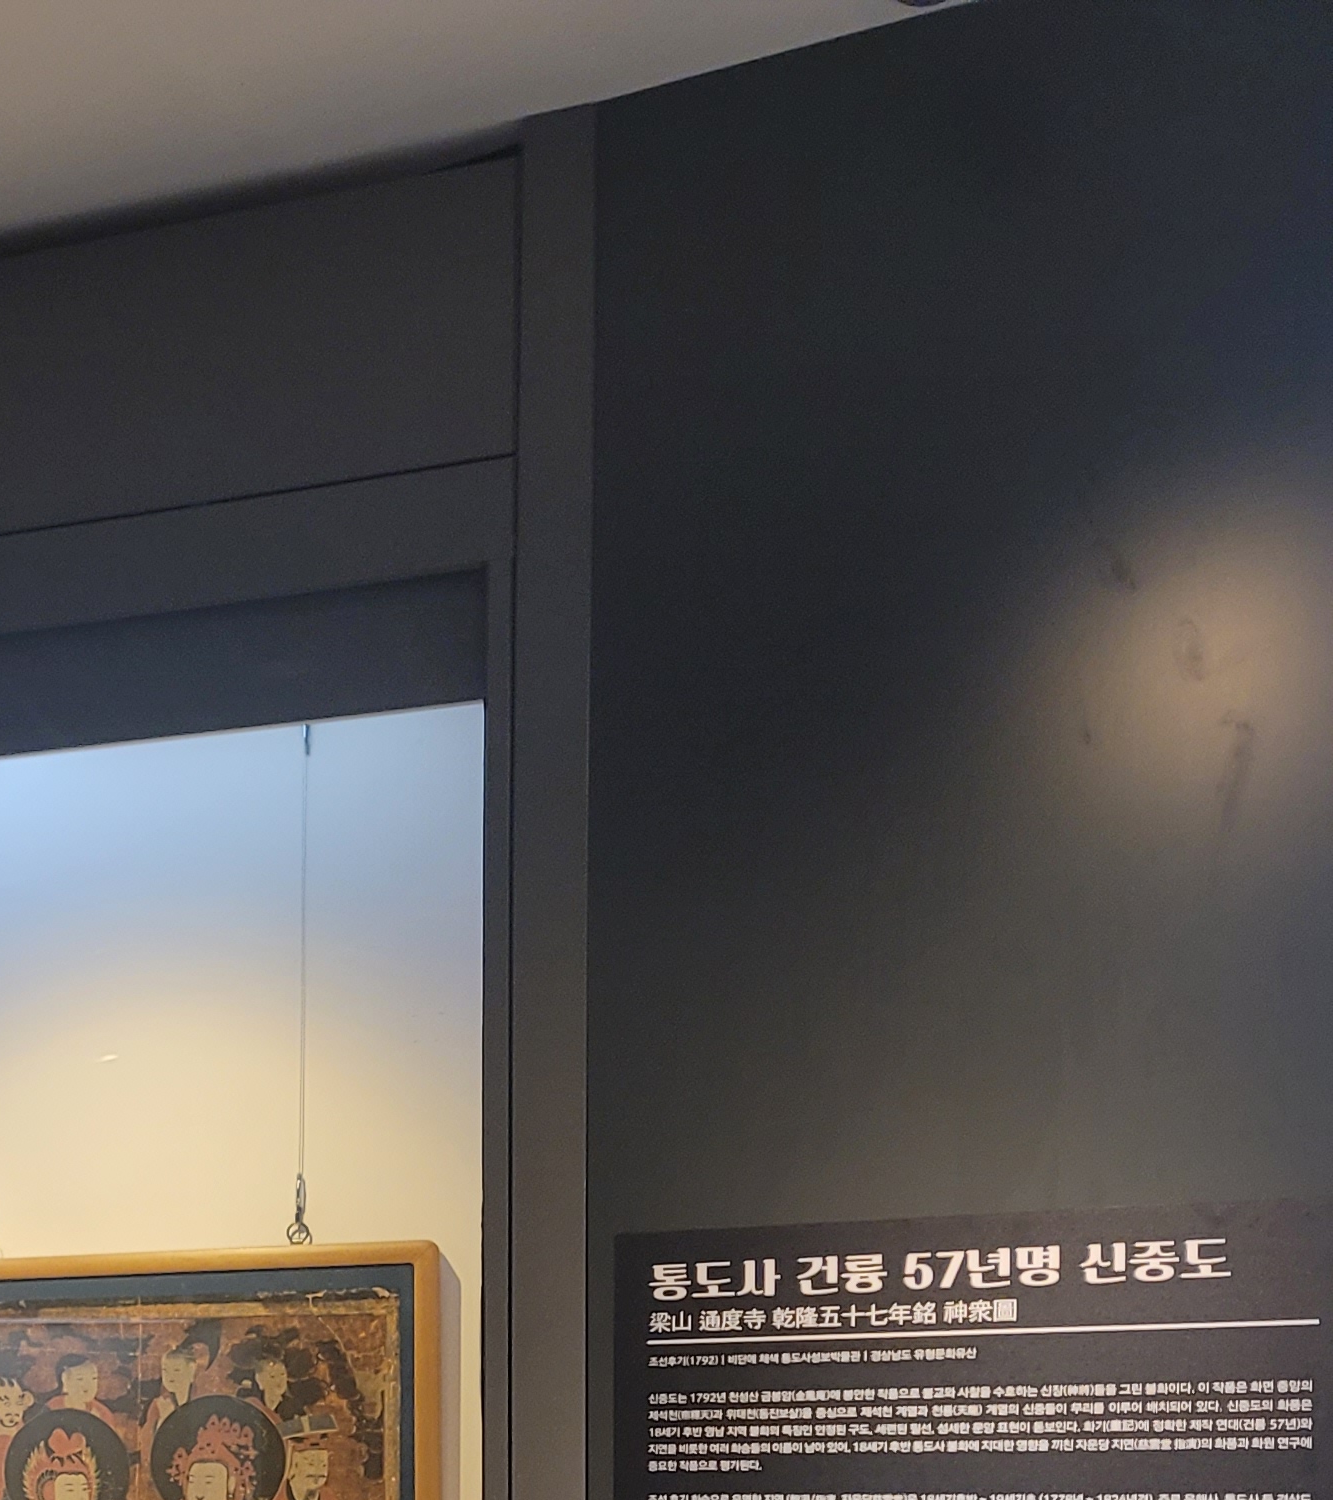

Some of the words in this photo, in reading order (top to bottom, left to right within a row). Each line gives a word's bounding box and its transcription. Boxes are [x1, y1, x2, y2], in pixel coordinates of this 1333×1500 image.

[648, 1258, 781, 1301] 통도사
[796, 1253, 888, 1296] 건륭
[902, 1243, 1062, 1291] 57년명
[1078, 1237, 1233, 1284] 신중도
[648, 1311, 692, 1334] 梁山
[698, 1308, 767, 1332] 通度寺
[771, 1302, 937, 1330] 乾隆五十七年銘
[942, 1298, 1018, 1324] 神衆圖
